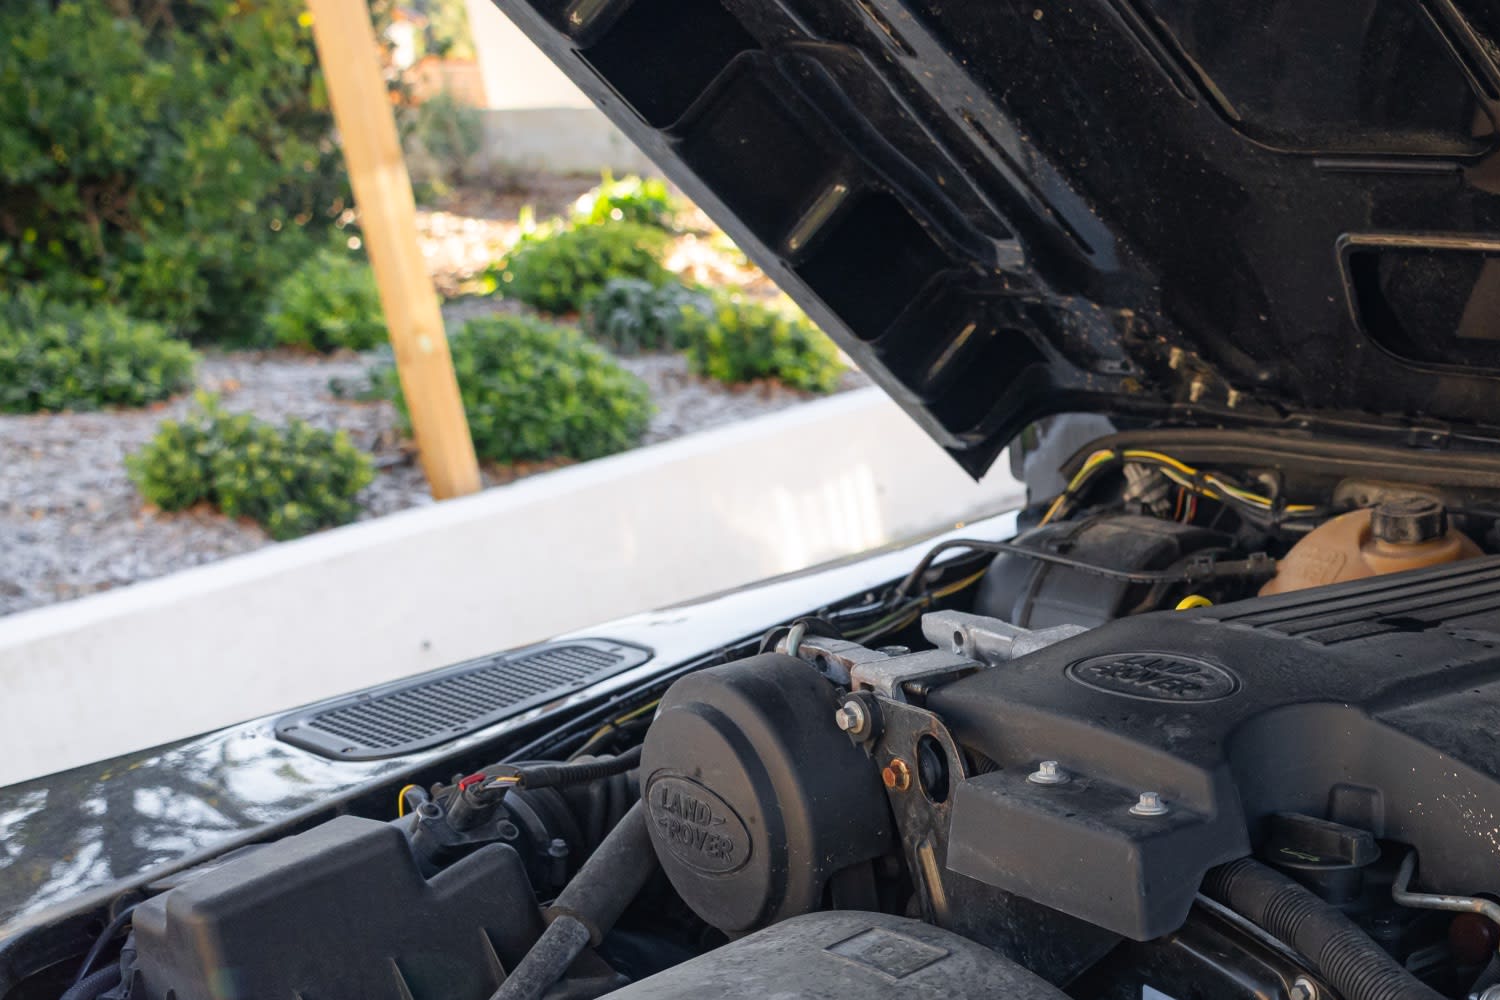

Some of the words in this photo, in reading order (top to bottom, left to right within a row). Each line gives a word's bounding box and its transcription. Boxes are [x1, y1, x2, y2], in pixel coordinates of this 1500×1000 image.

[1105, 664, 1203, 696] ROVER
[1115, 655, 1202, 677] LAND
[661, 785, 713, 827] LAND
[669, 819, 735, 864] ROVER
